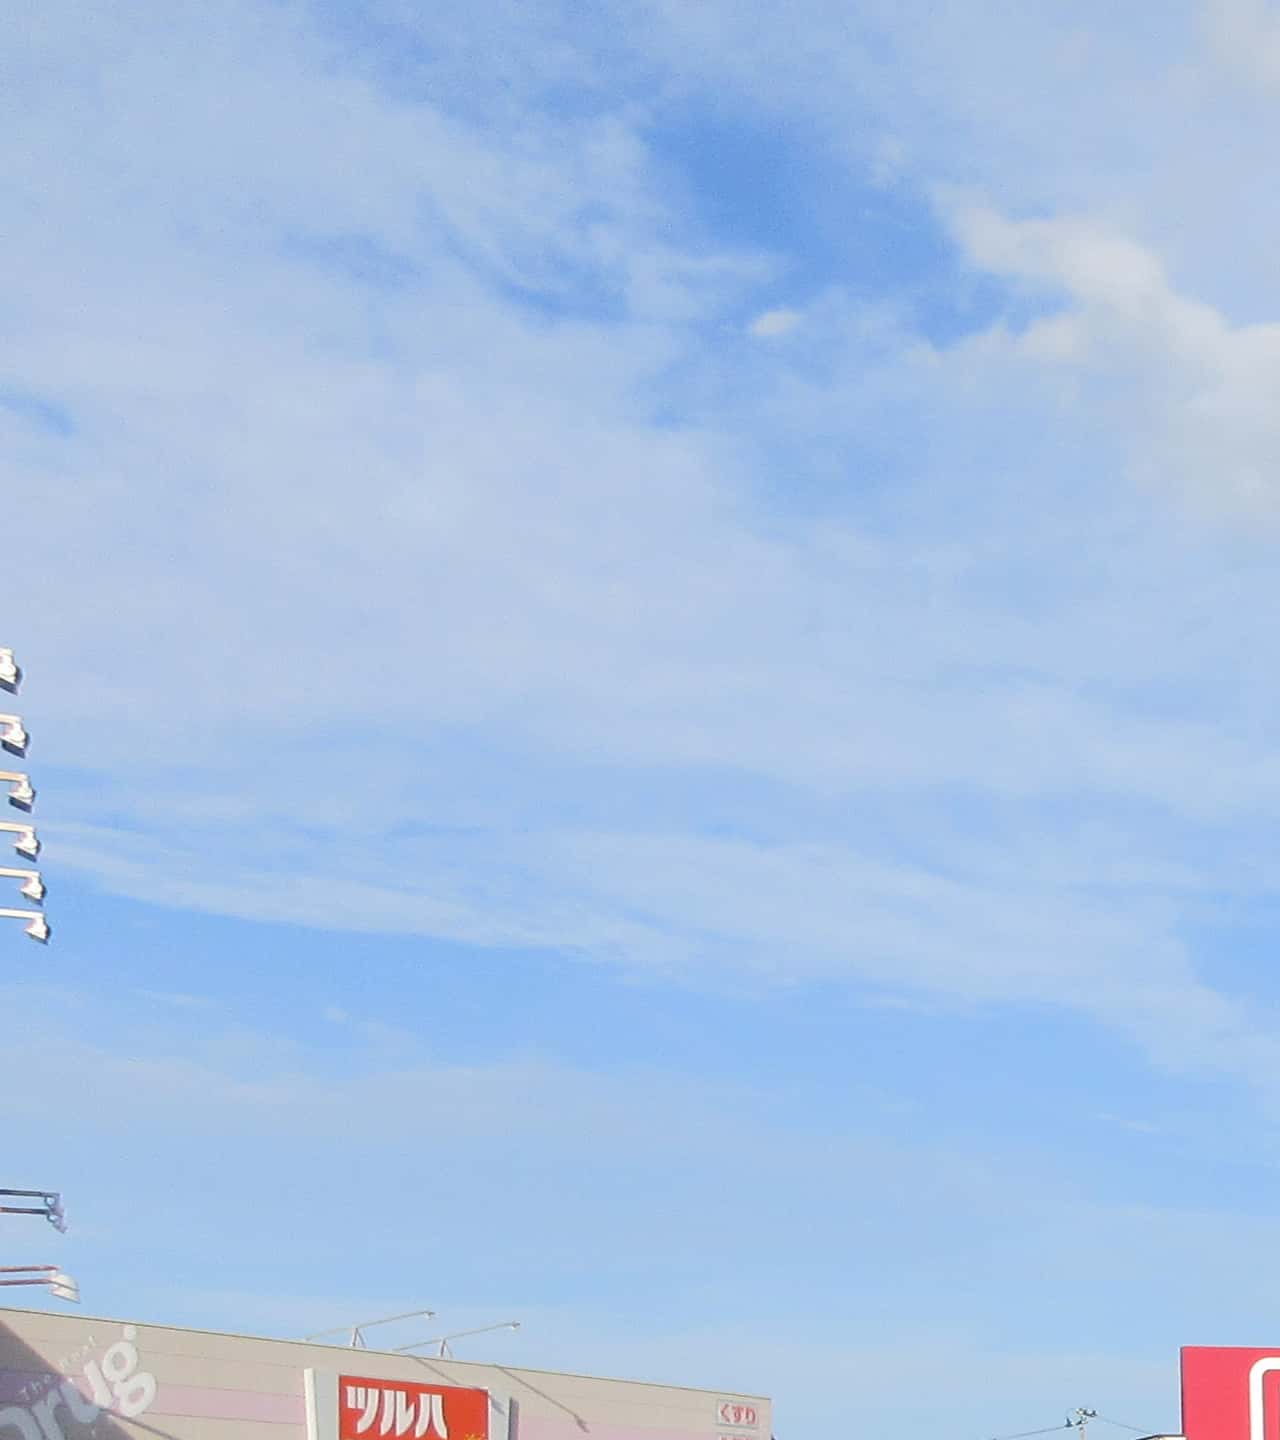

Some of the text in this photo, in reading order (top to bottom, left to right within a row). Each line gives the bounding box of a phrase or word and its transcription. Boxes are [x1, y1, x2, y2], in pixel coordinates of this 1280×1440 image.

[346, 1385, 448, 1440] ツルハ
[720, 1403, 756, 1424] くすり
